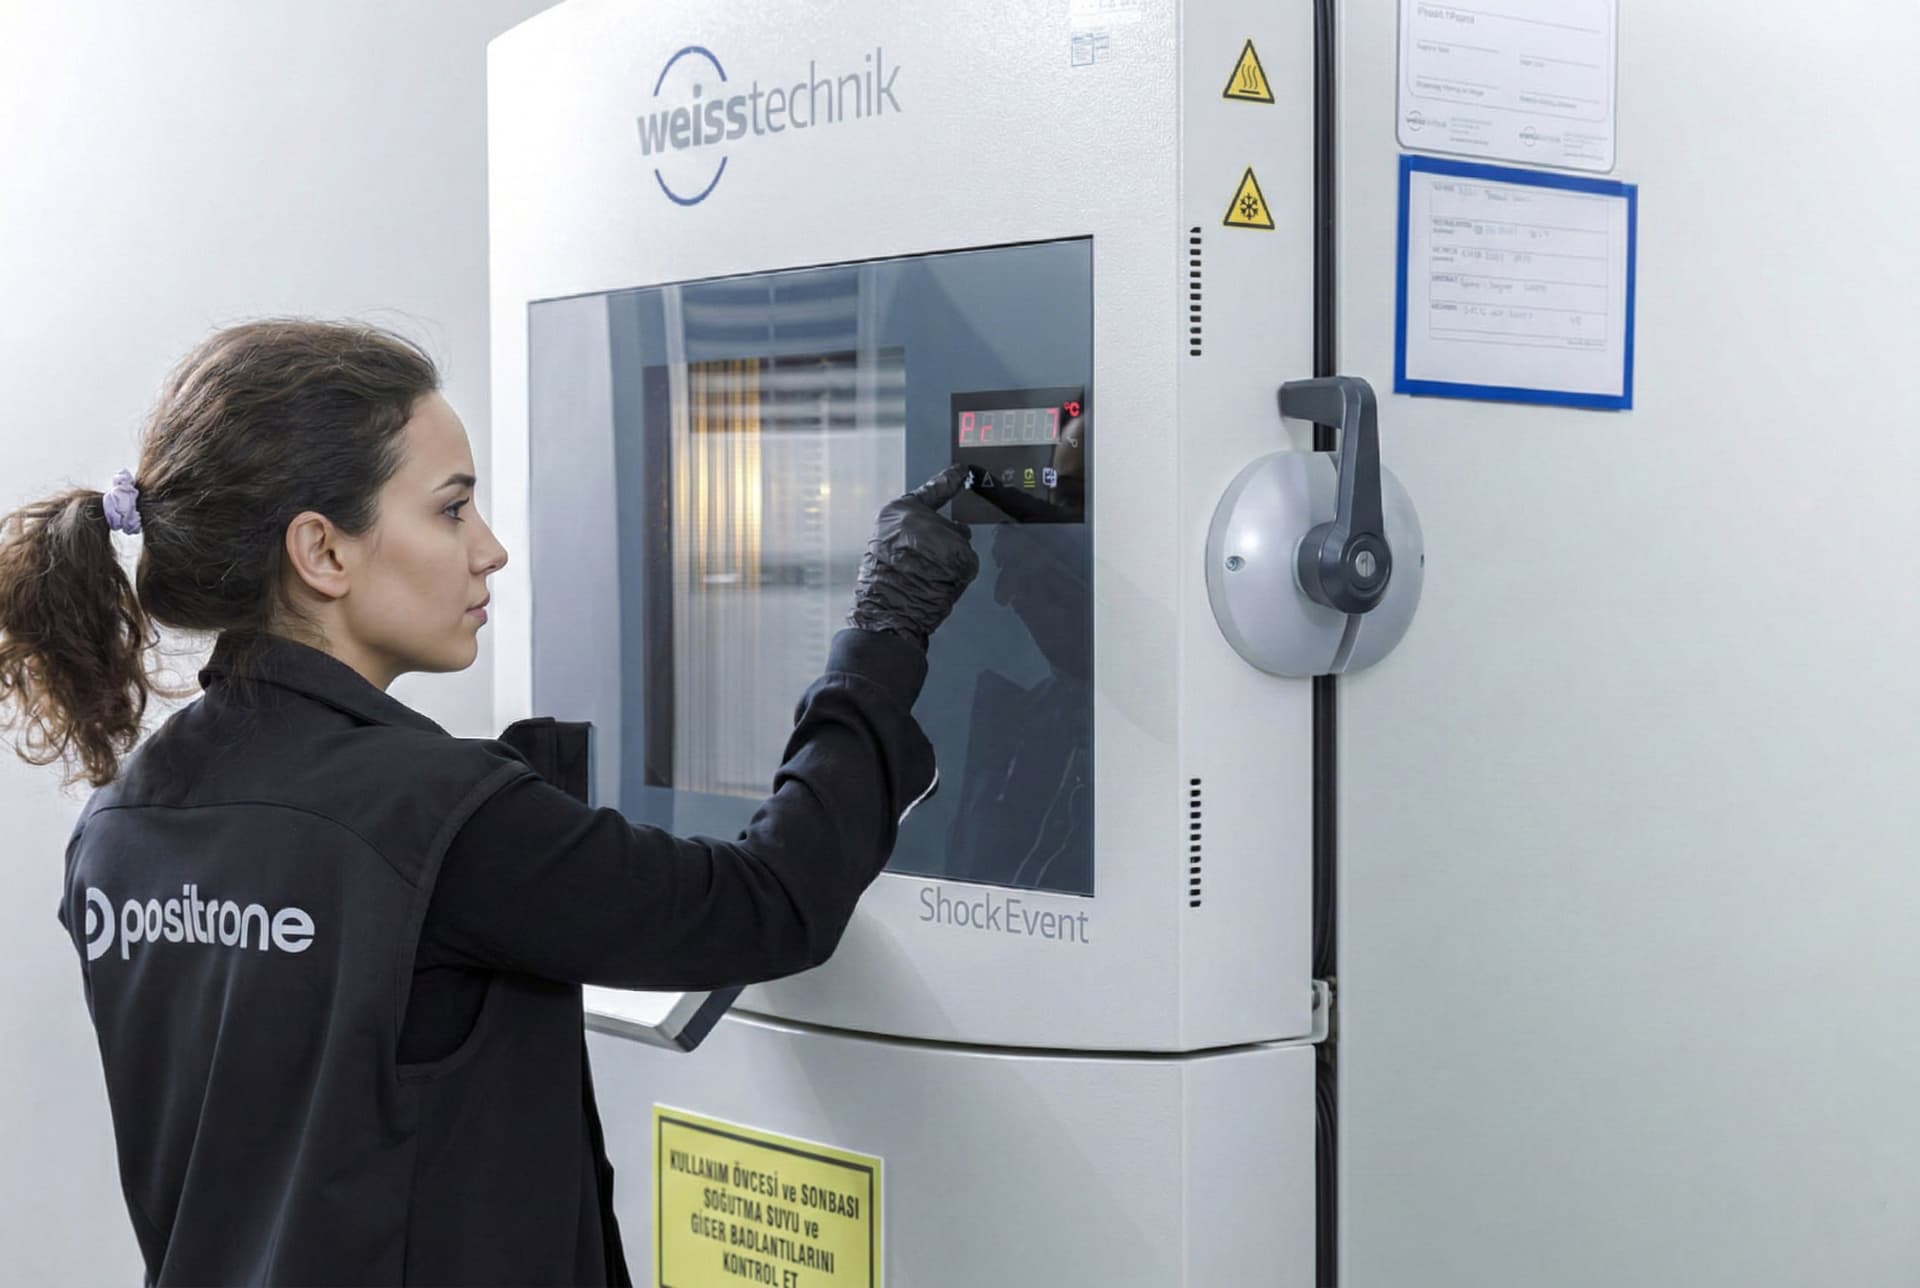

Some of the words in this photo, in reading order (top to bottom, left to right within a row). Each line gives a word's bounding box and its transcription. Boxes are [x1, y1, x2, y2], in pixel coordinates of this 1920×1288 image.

[121, 884, 316, 960] positrone
[670, 1149, 729, 1185] KULLANIM
[782, 1183, 798, 1203] ve
[704, 1187, 763, 1223] SOĞUTMA
[767, 1204, 800, 1233] SUYU
[804, 1219, 819, 1239] ve
[723, 1251, 779, 1287] KONTROL
[783, 1269, 799, 1288] ET
